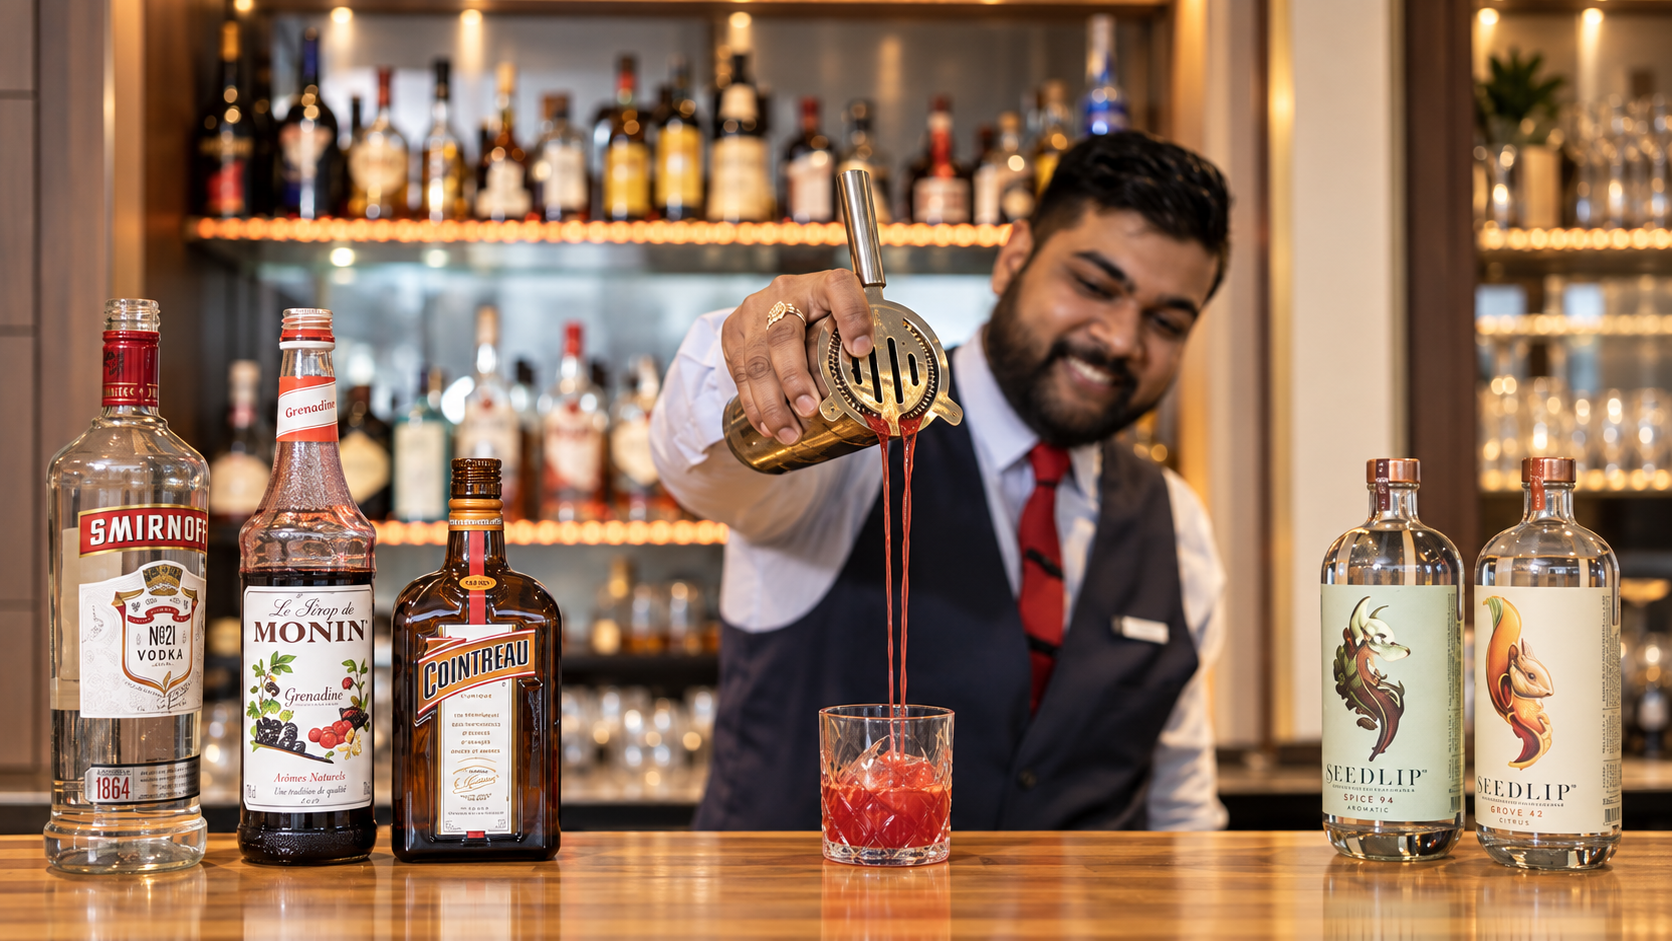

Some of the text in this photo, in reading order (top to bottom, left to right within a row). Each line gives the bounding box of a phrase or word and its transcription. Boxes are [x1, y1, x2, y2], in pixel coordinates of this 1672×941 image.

[285, 400, 335, 418] Grenadine
[90, 514, 206, 546] SMIRNOFF
[268, 598, 293, 617] Le
[341, 601, 354, 616] de
[253, 620, 366, 643] MONIN
[137, 649, 183, 661] VODKA
[424, 639, 529, 699] COINTREAU
[284, 686, 343, 707] Grenadine
[309, 771, 346, 782] Naturels
[1325, 763, 1421, 786] SEEDLIP
[96, 776, 130, 800] 1864
[1477, 775, 1570, 801] SEEDLIP
[1343, 793, 1393, 804] SPICE 94
[1347, 805, 1389, 813] AROMATIC
[1490, 805, 1543, 818] GROVE 42
[1499, 817, 1530, 826] CITRUS
